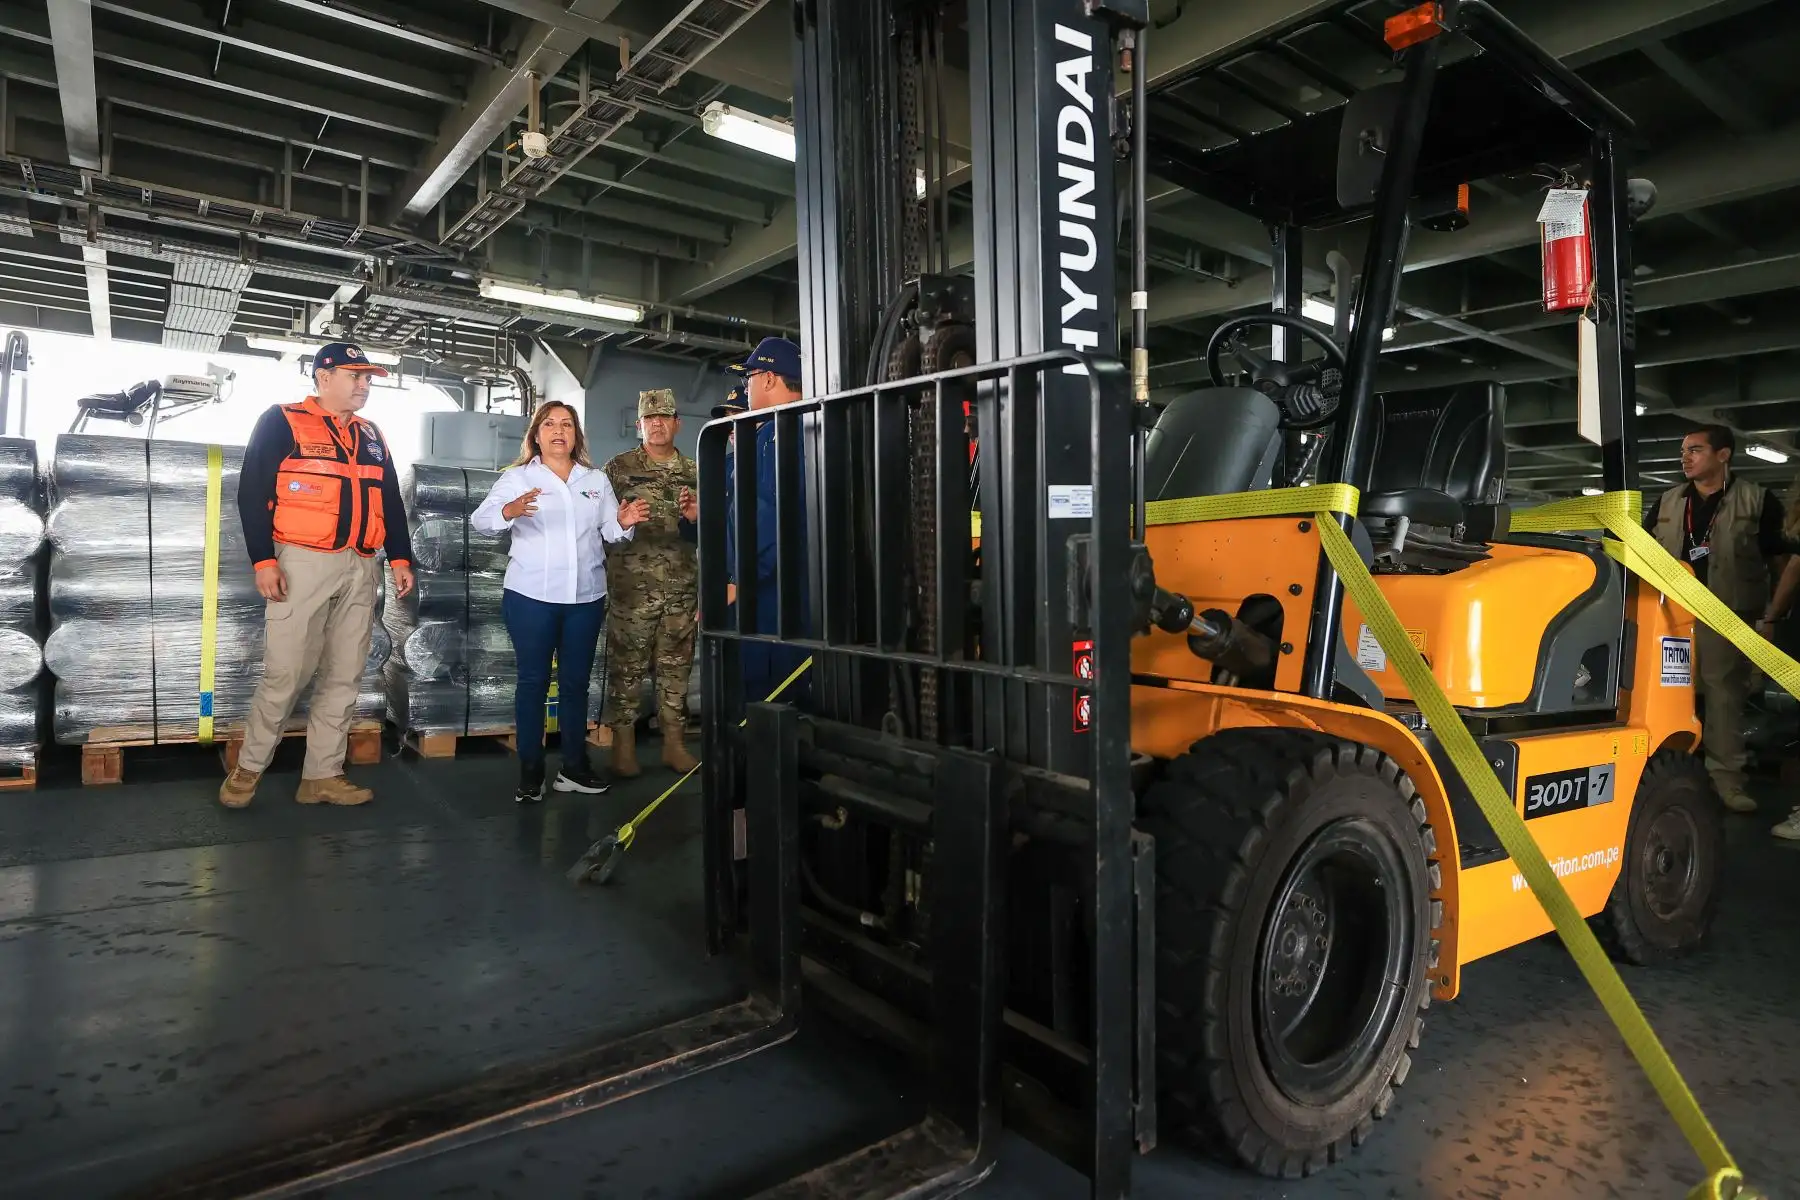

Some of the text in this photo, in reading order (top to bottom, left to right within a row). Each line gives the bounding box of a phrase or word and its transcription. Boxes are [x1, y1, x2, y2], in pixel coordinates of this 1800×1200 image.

[1055, 23, 1099, 376] HYUNDAI
[172, 377, 211, 388] Raymarine
[1663, 646, 1690, 663] TRITON
